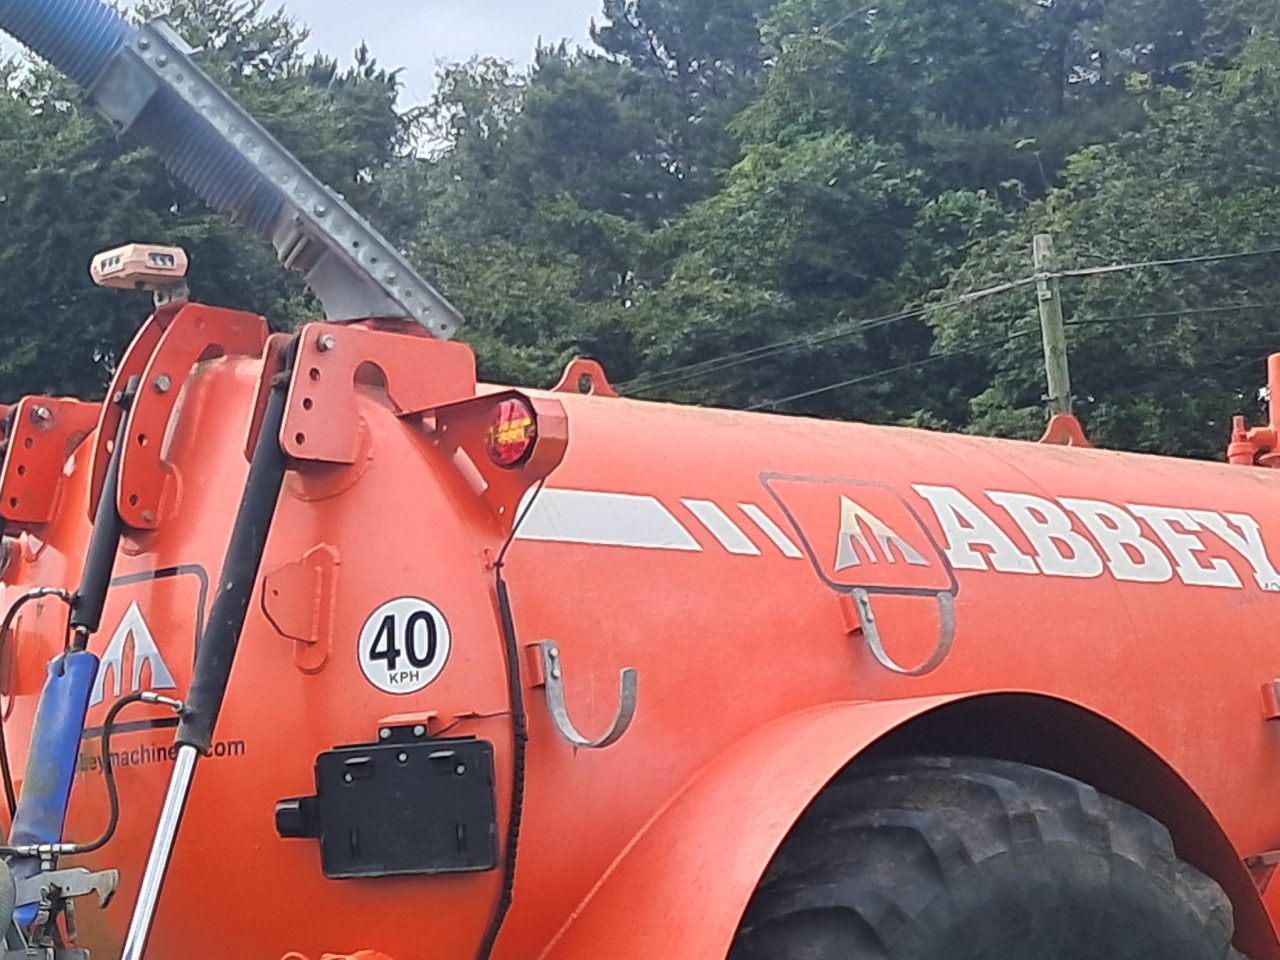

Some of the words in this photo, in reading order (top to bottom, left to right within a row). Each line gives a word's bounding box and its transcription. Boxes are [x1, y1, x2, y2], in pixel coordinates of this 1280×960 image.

[910, 483, 1280, 593] ABBEY
[369, 610, 438, 671] 40
[388, 670, 420, 684] KPH
